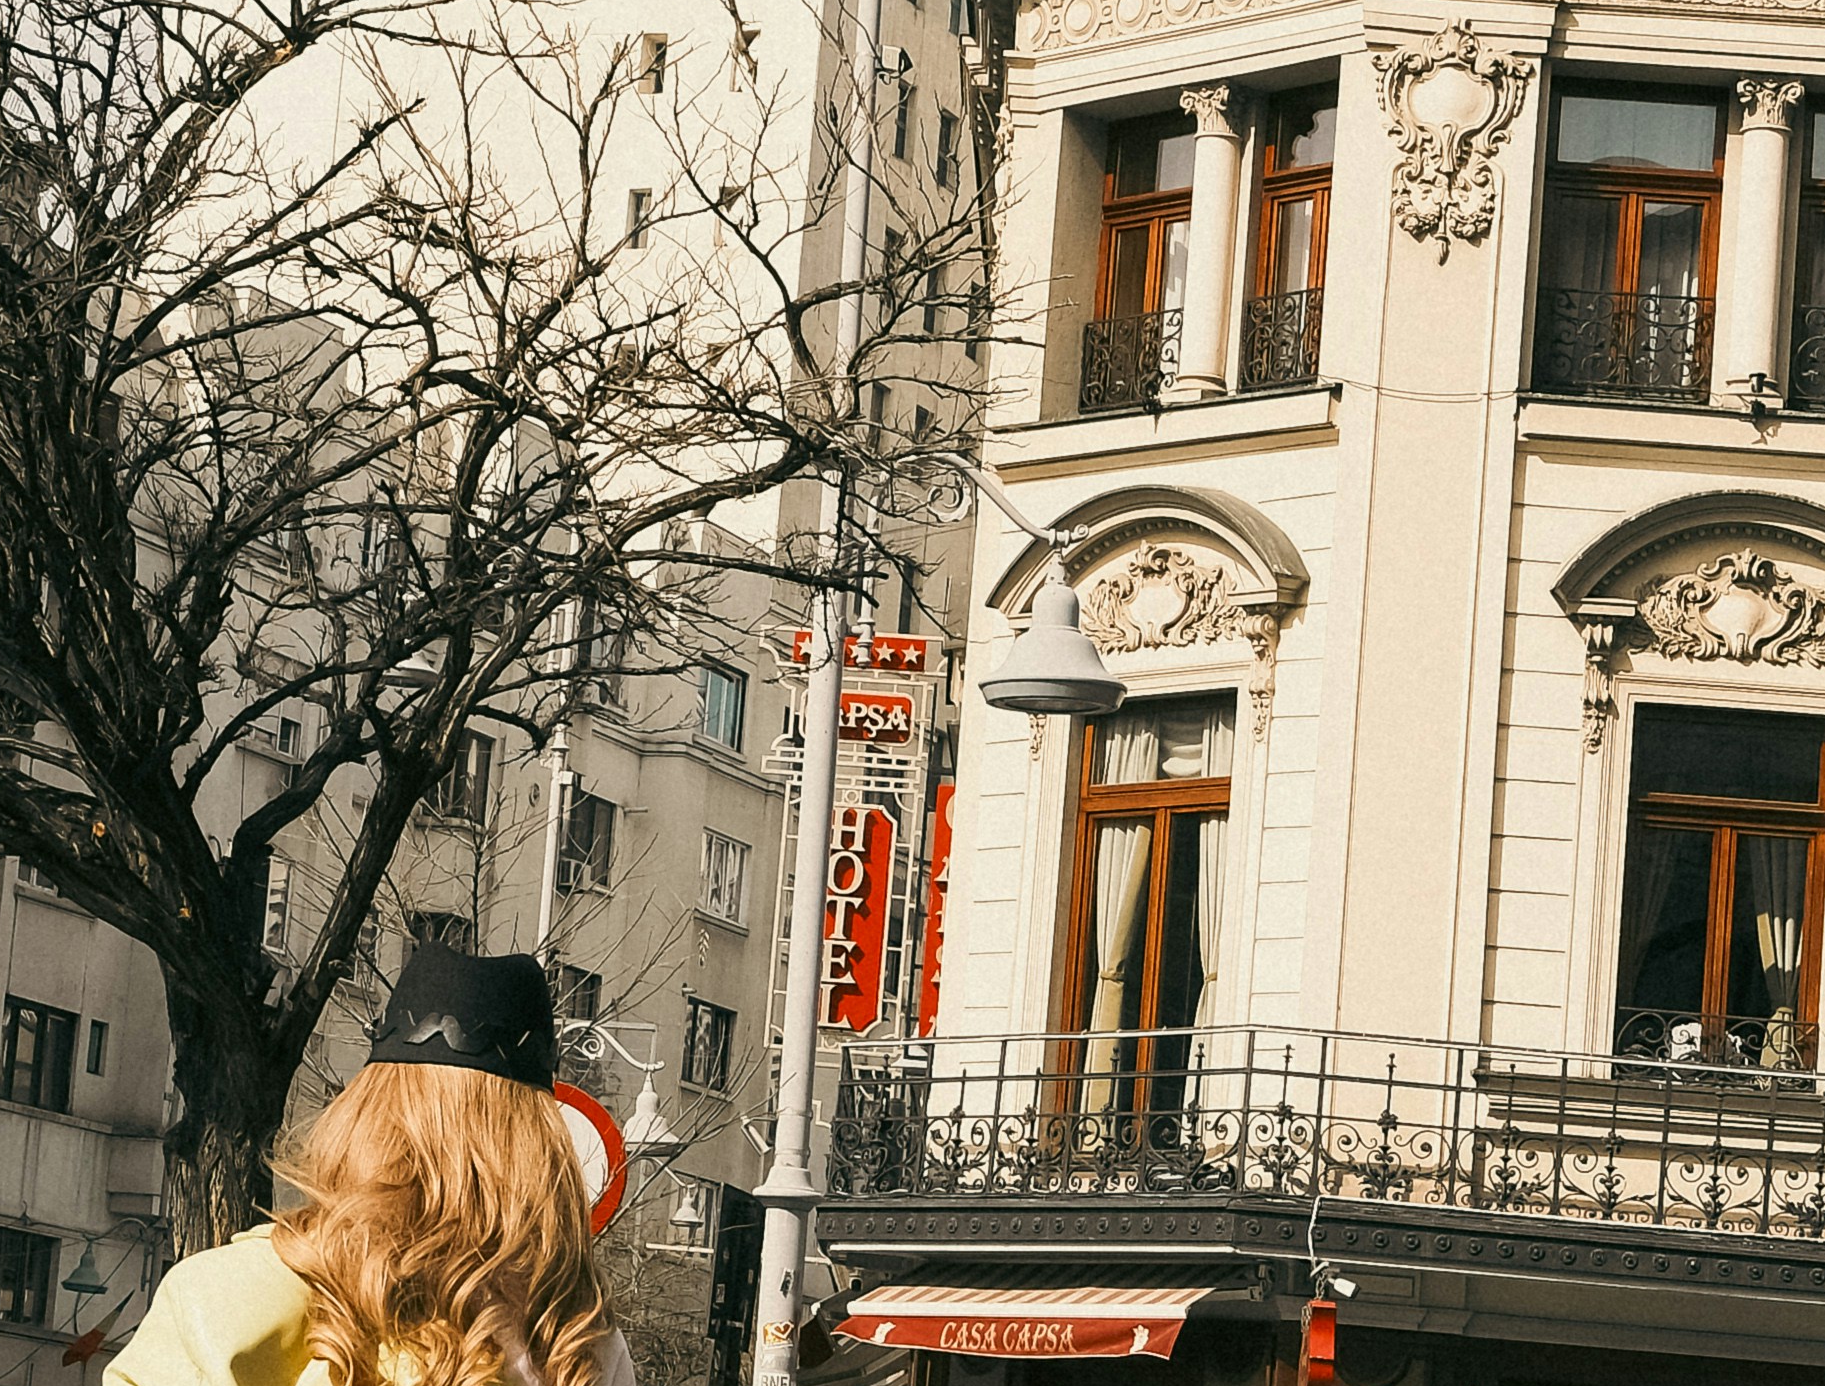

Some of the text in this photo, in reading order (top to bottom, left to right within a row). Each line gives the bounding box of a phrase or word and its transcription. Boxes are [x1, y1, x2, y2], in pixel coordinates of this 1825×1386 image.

[819, 809, 873, 1030] HOTEL
[940, 1321, 1077, 1353] CASA CAPSA
